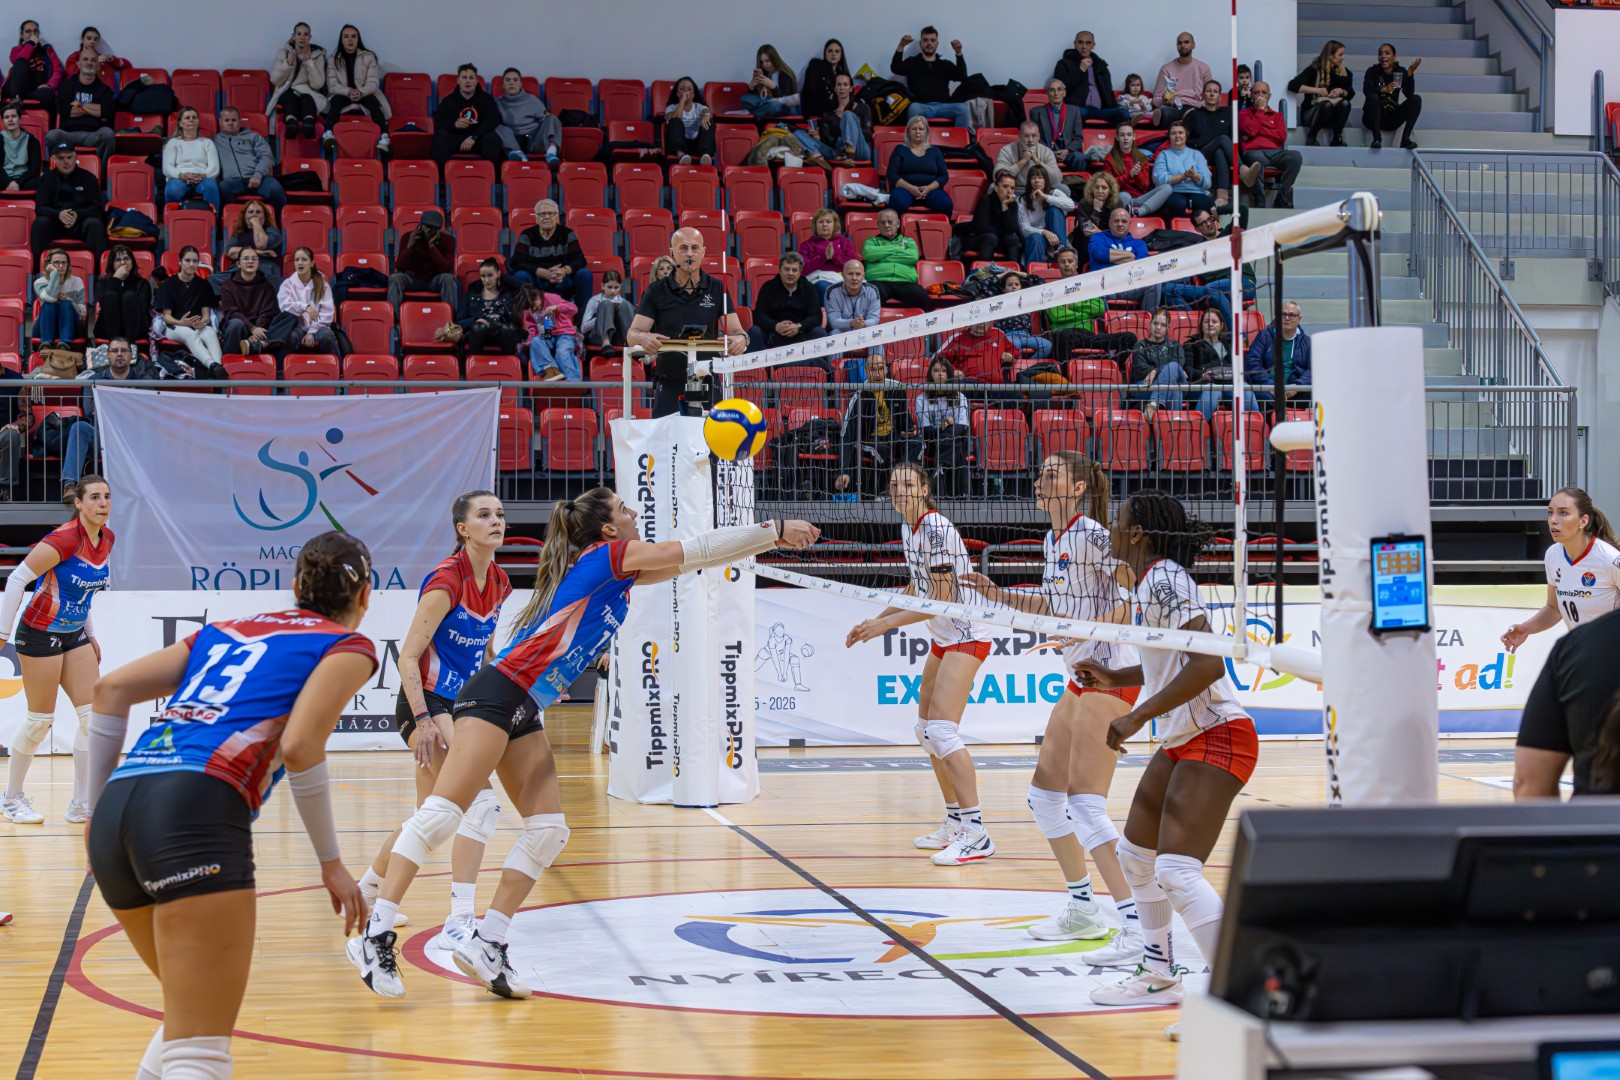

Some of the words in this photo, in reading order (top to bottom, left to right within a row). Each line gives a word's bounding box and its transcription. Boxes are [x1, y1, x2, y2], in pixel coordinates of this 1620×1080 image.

[638, 453, 656, 544] mixPRO
[1562, 600, 1580, 623] 10
[882, 627, 1065, 665] TipxPR
[177, 641, 269, 704] 13
[877, 673, 1065, 705] EXALIG
[1454, 652, 1516, 691] ad!
[642, 641, 667, 770] TippmixPRO
[721, 640, 743, 770] TippmixPRO
[769, 696, 796, 711] 2026
[333, 716, 390, 730] HÁZÓ
[672, 693, 681, 778] TippmixPRO
[144, 864, 221, 892] TippmixPRO
